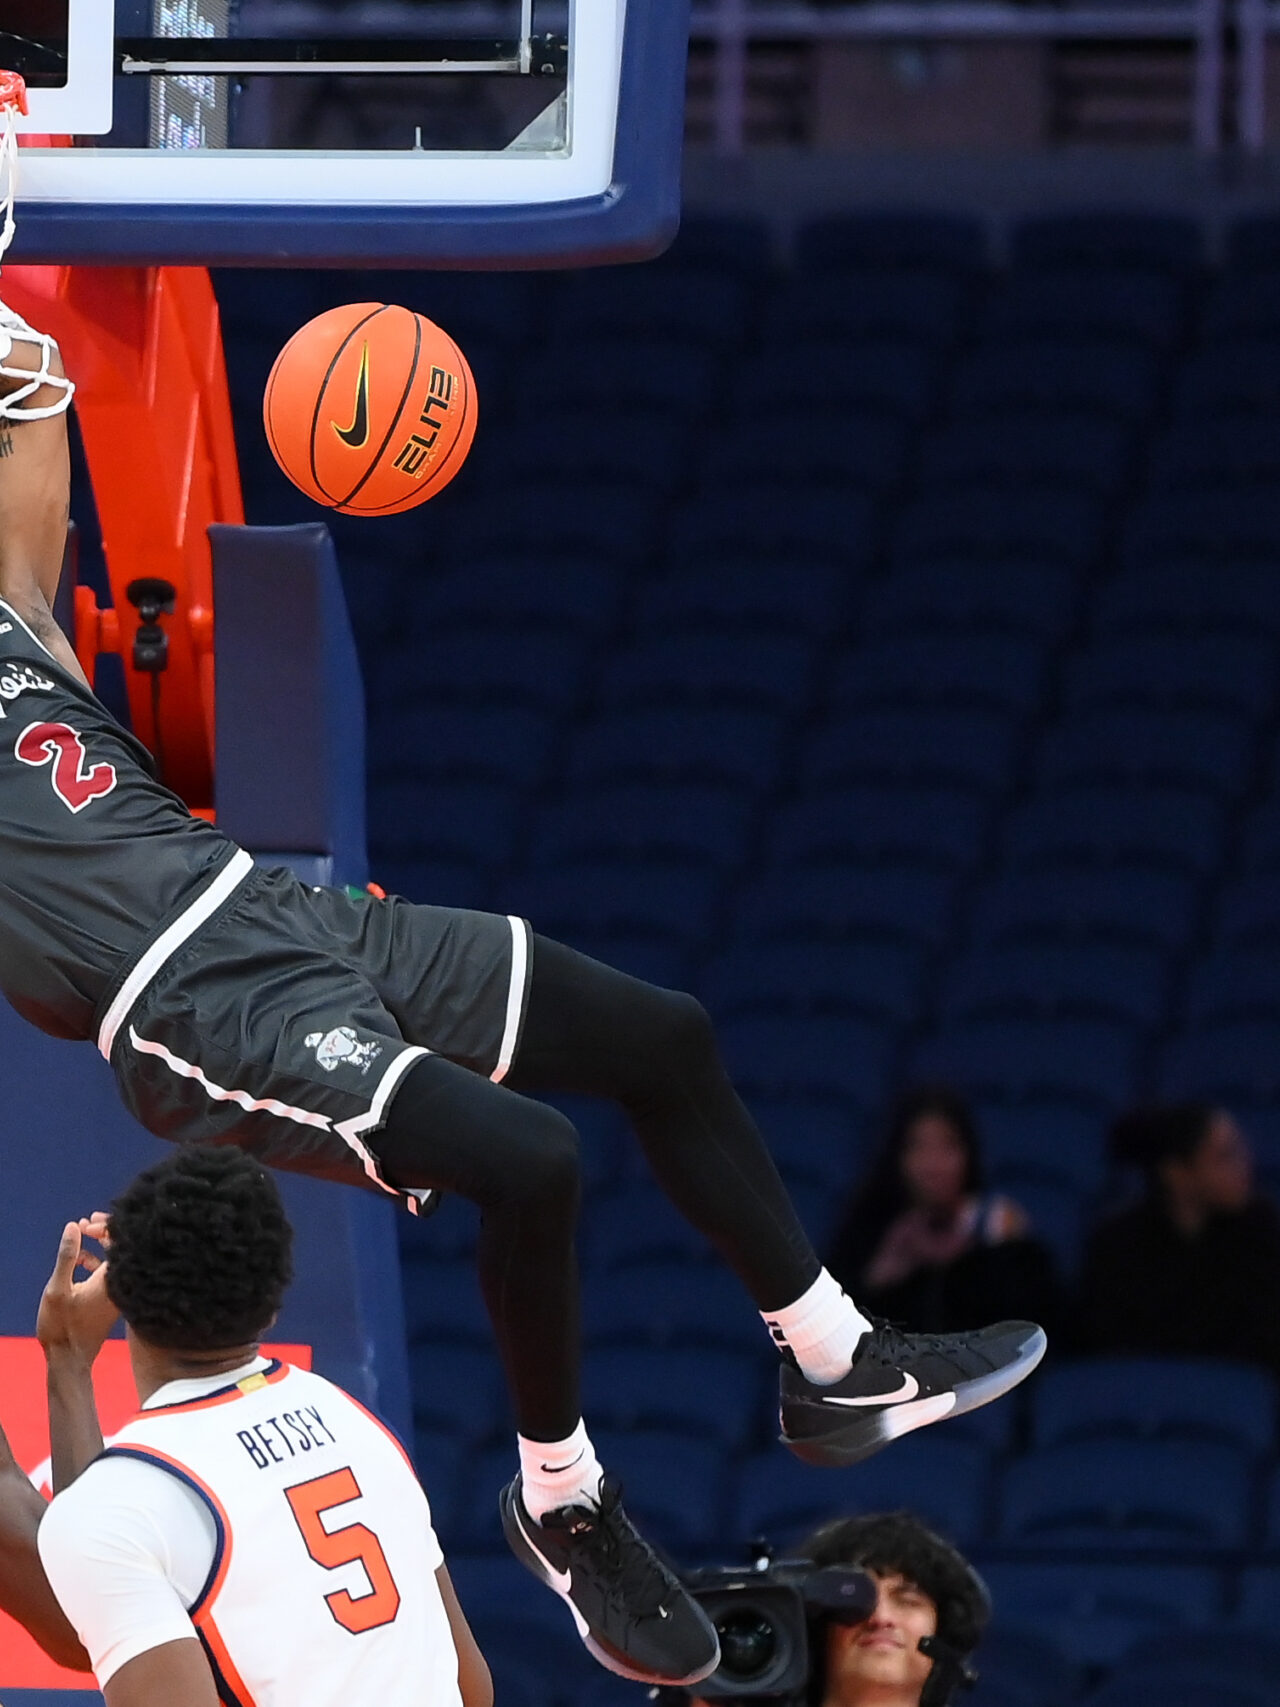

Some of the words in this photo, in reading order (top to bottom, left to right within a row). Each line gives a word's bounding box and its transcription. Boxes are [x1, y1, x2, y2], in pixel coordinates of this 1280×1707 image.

[391, 364, 453, 477] ELITE
[14, 721, 117, 814] 2
[236, 1405, 336, 1469] BETSEY
[283, 1466, 401, 1635] 5
